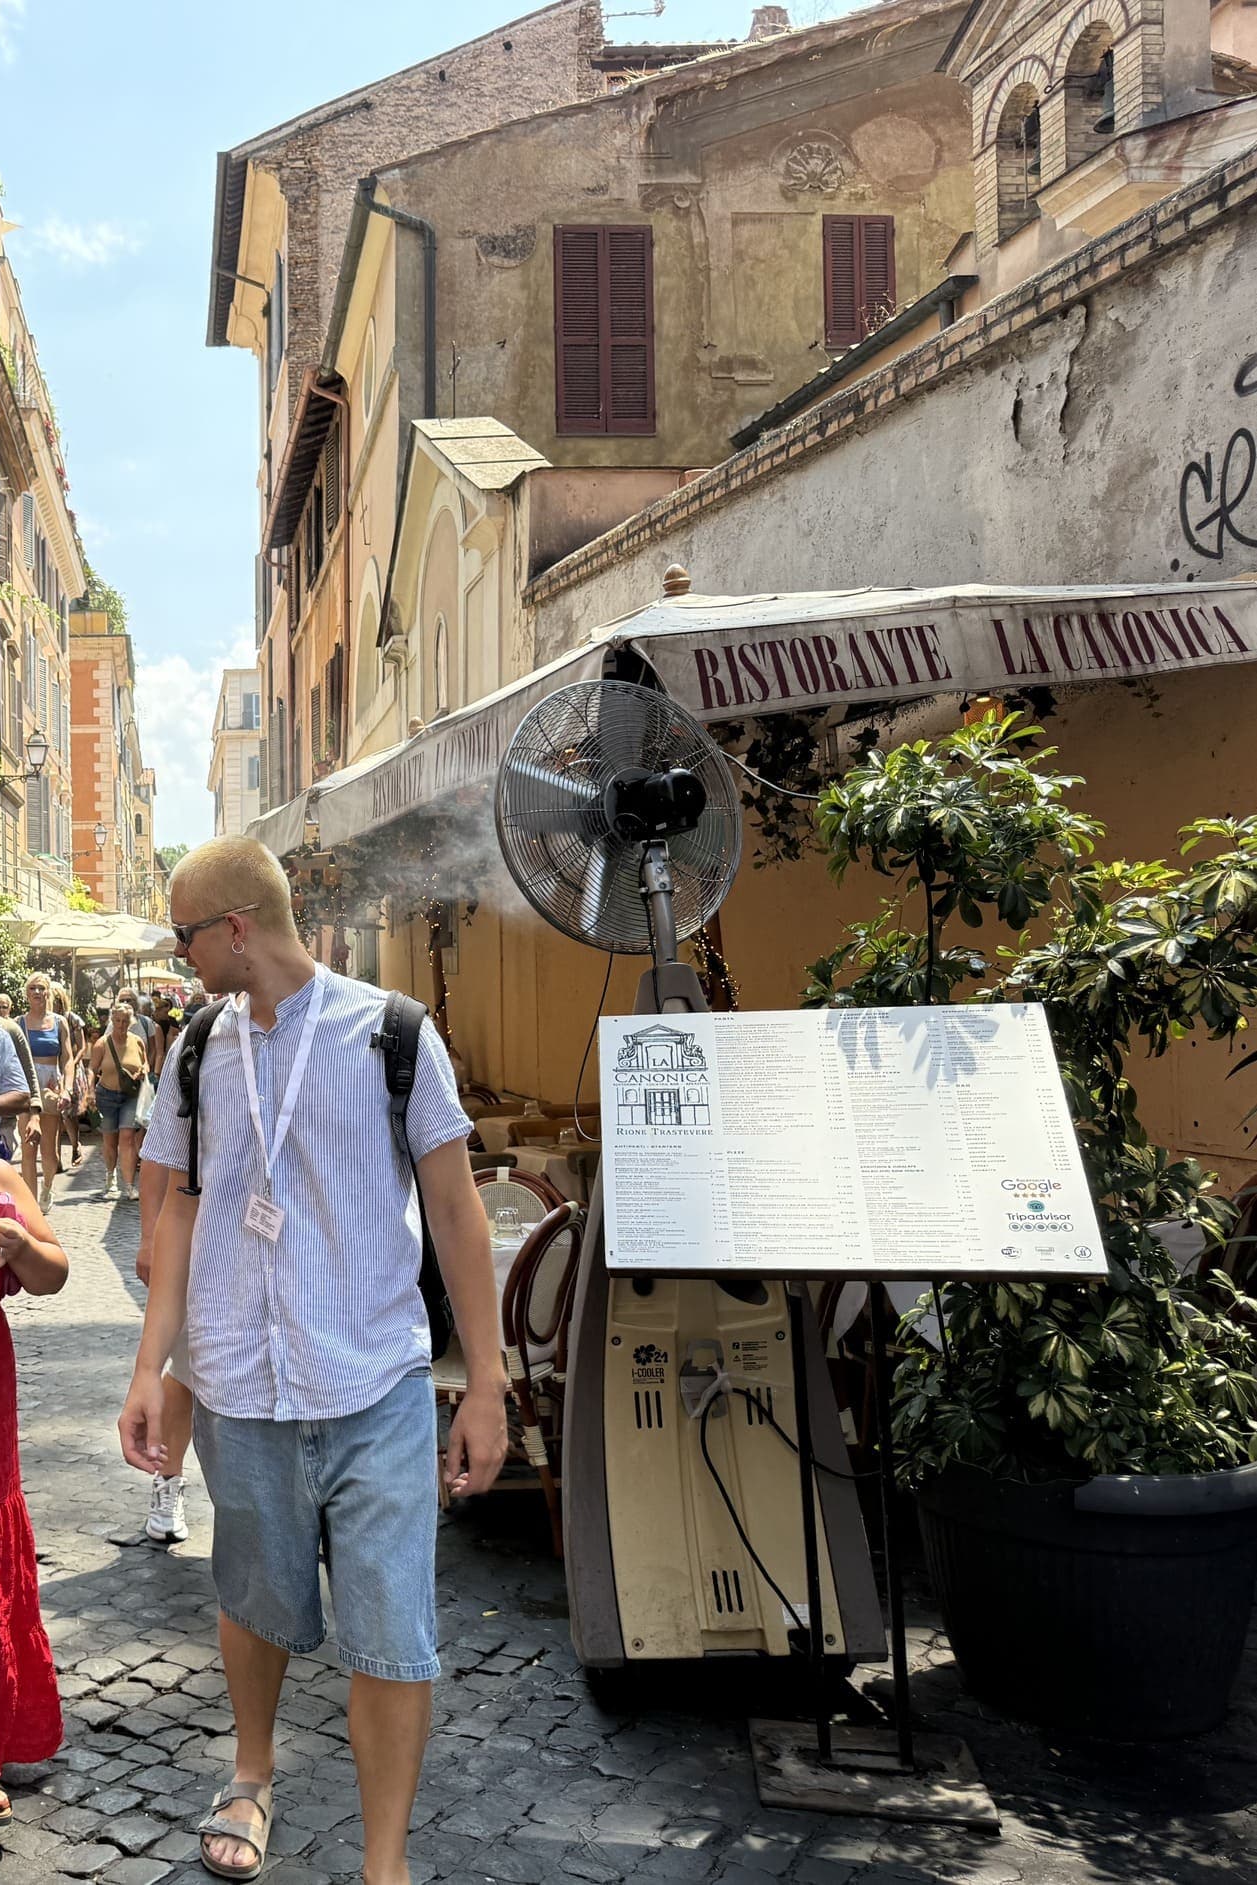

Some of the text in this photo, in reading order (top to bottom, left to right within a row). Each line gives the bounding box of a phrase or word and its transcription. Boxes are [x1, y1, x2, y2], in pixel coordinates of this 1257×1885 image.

[692, 605, 1252, 709] RISTORANTE LA CANONICA
[652, 1058, 670, 1067] LA
[614, 1072, 709, 1083] CANONICA
[615, 1127, 714, 1136] RIONE TRASTEVERE
[1000, 1178, 1062, 1193] Google
[1006, 1212, 1072, 1222] Tripadvisor
